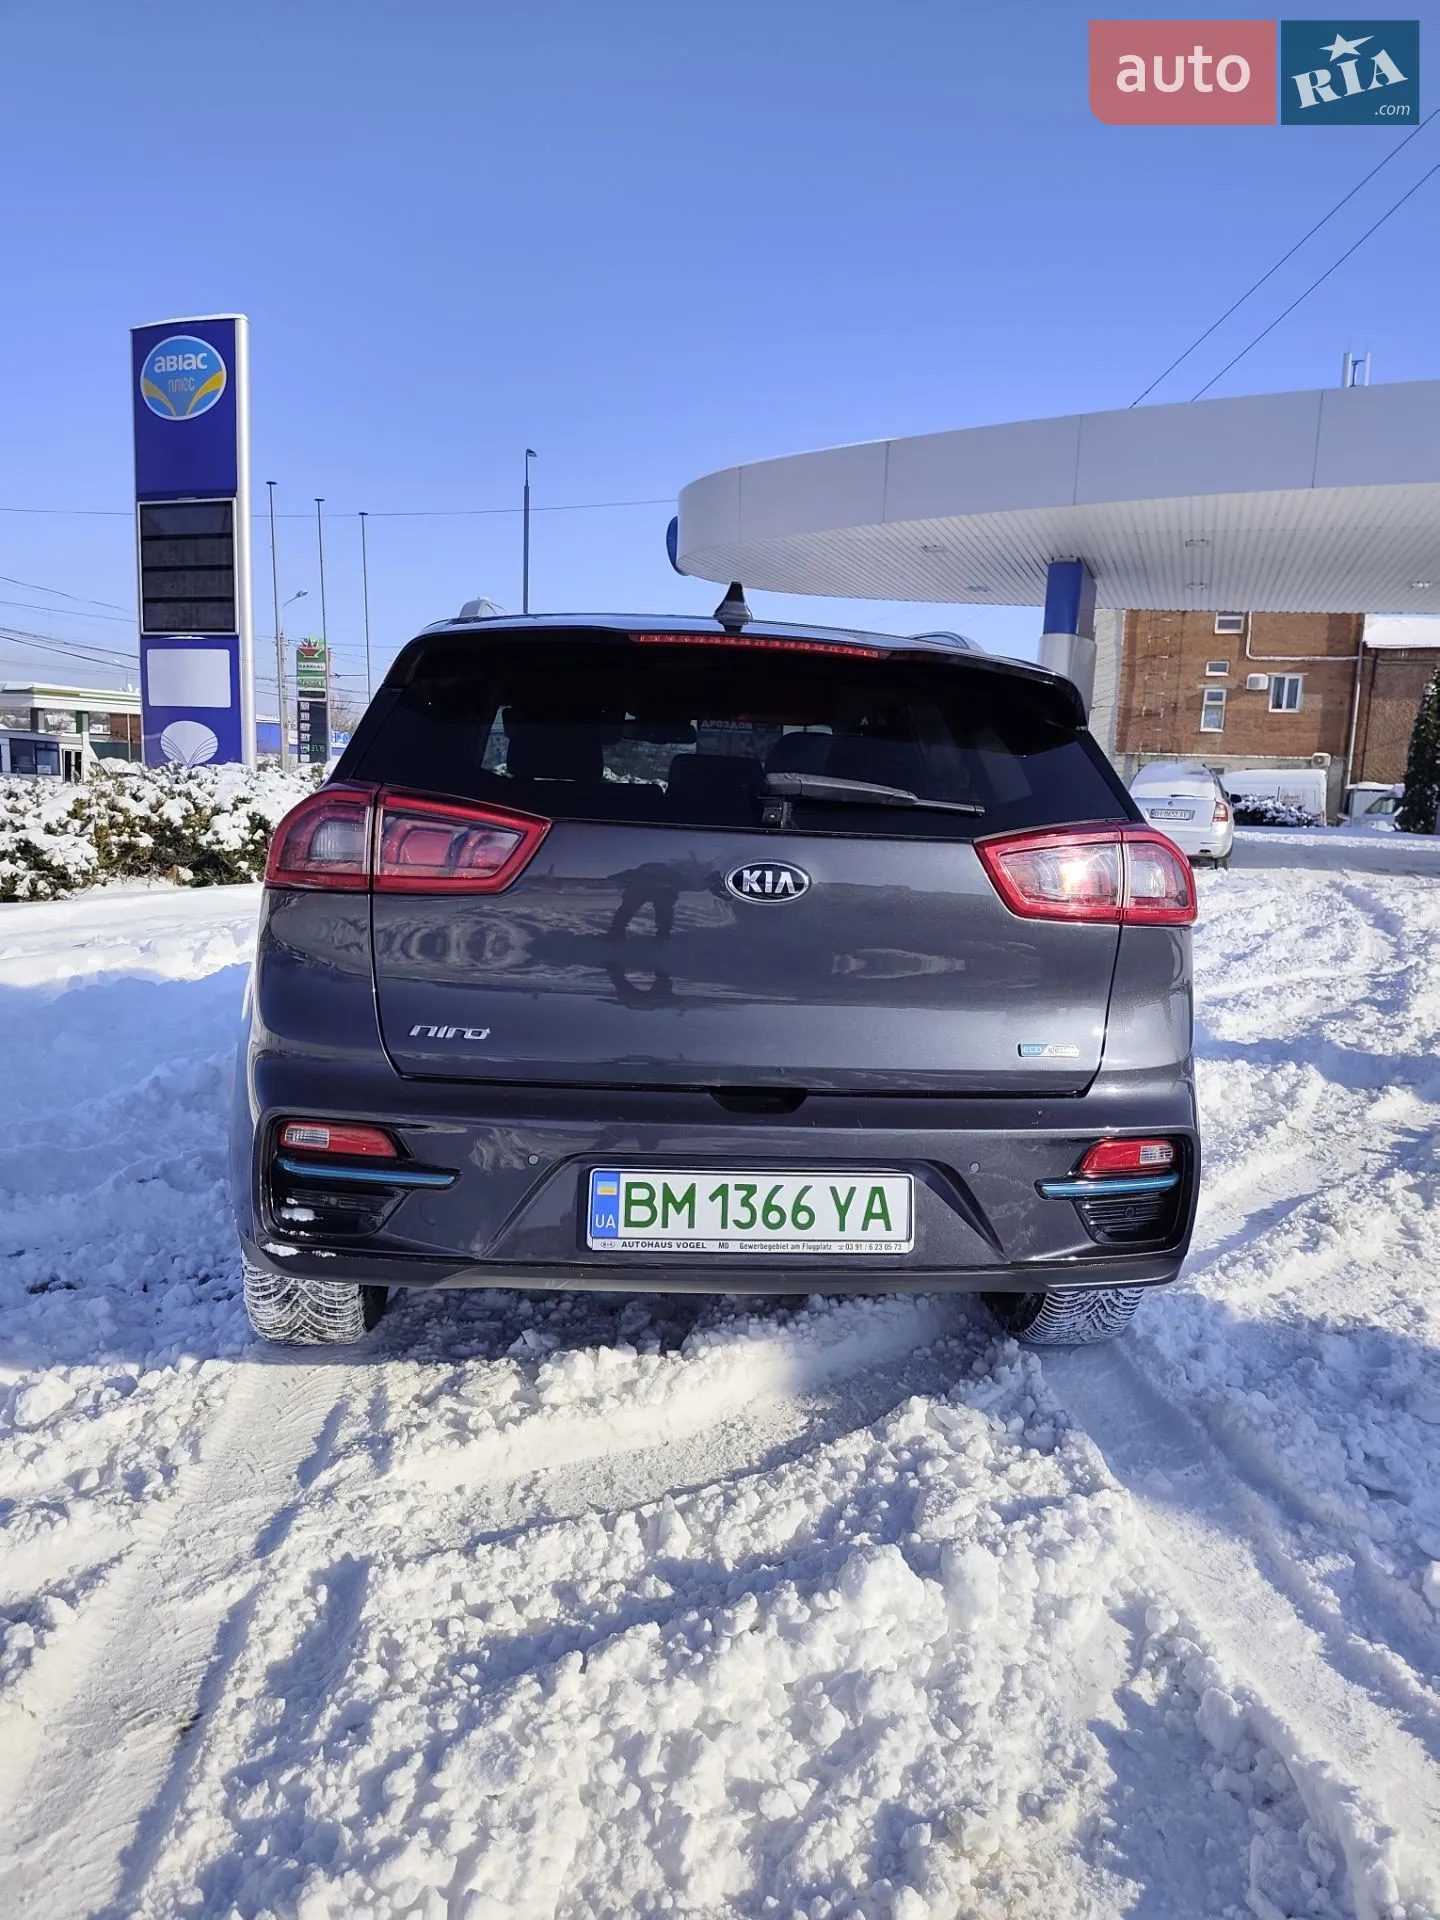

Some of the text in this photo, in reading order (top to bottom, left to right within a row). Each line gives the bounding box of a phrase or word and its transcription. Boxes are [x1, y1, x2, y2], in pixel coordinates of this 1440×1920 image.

[742, 869, 795, 894] KIA
[409, 1024, 491, 1040] niro
[623, 1181, 892, 1232] BM 1366 YA
[595, 1214, 616, 1229] UA
[621, 1241, 673, 1249] AUTOHAUS
[676, 1241, 707, 1249] VOGEL
[739, 1242, 790, 1252] Gewerbegebiet
[802, 1243, 832, 1252] Flugplatz
